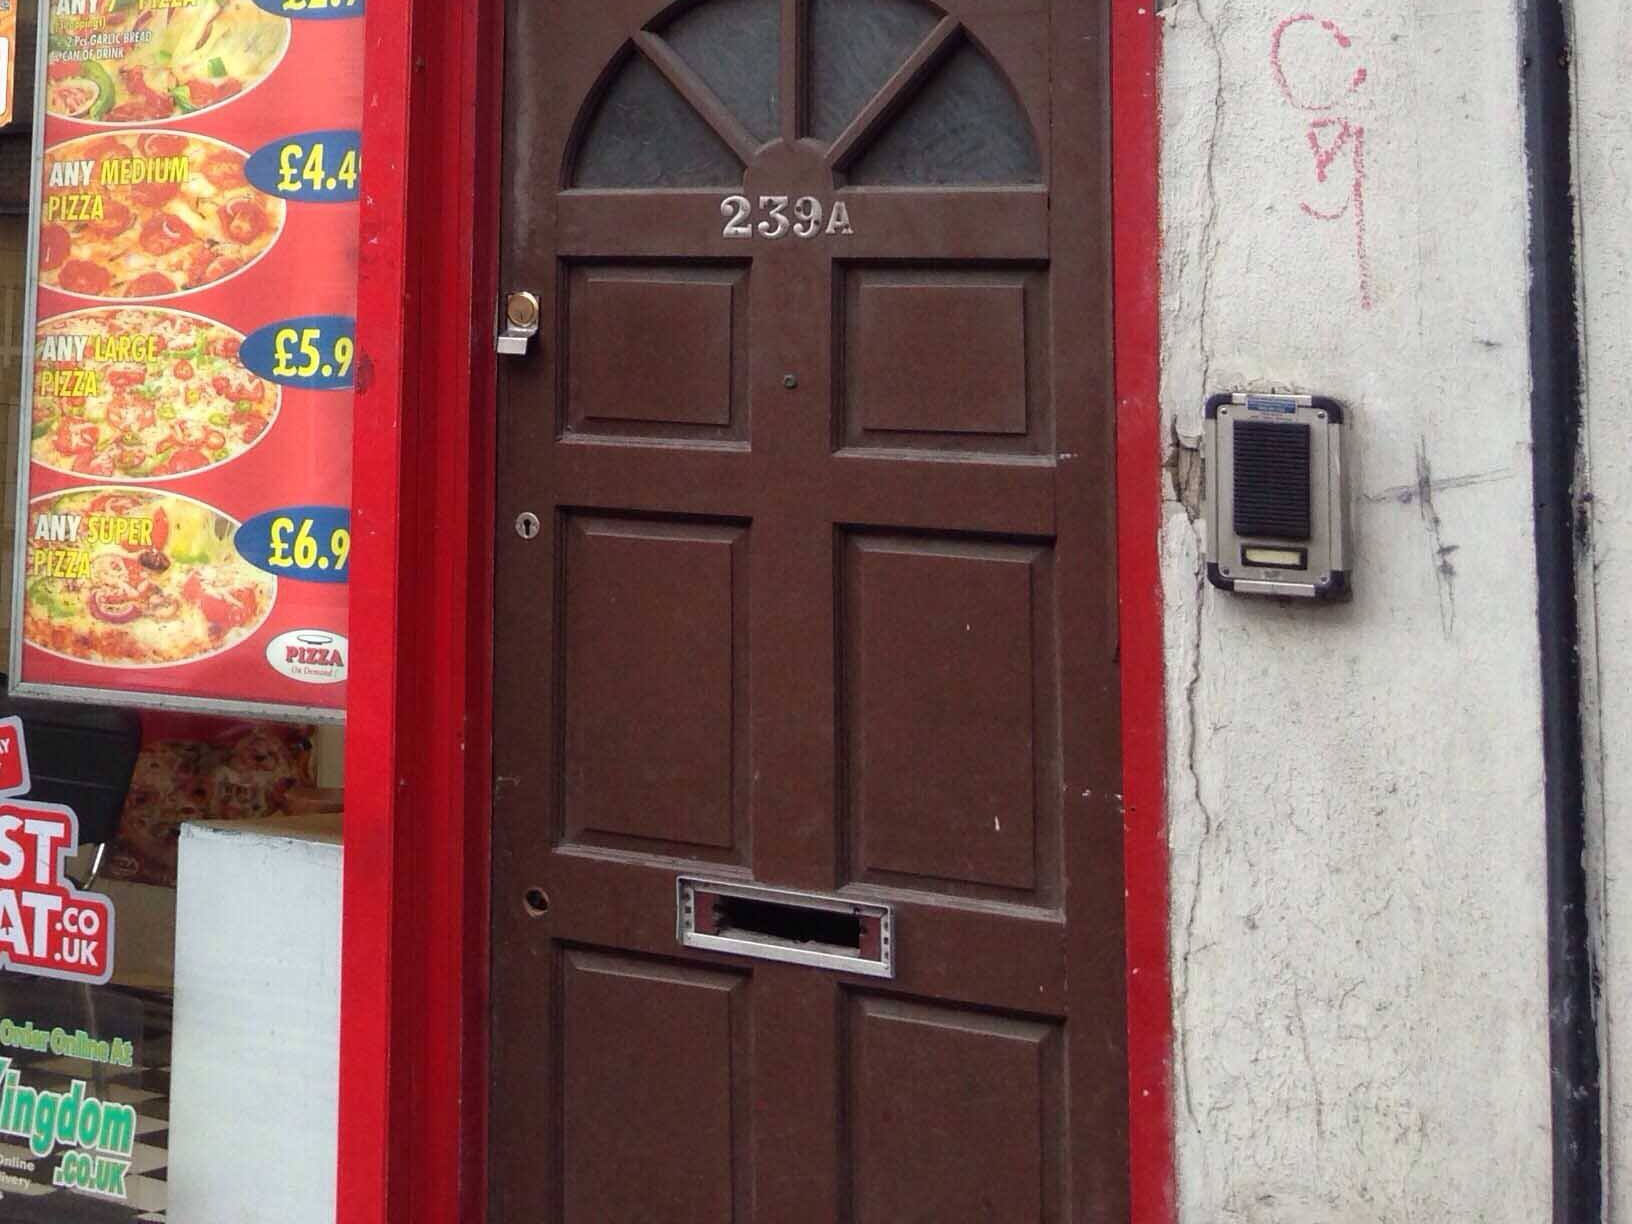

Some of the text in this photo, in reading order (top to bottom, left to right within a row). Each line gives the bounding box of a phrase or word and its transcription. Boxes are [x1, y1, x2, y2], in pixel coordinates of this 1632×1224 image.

[96, 47, 125, 60] DRINK
[49, 155, 190, 188] ANY MEDIUM
[277, 143, 363, 193] £4.4
[48, 194, 104, 222] PIZZA
[720, 194, 855, 239] 239A
[41, 334, 159, 363] ANY LARGE
[40, 368, 98, 398] PIZZA
[34, 514, 154, 547] ANY SUPER
[32, 548, 94, 580] PIZZA
[285, 645, 345, 667] PIZZA
[50, 1026, 110, 1064] Online
